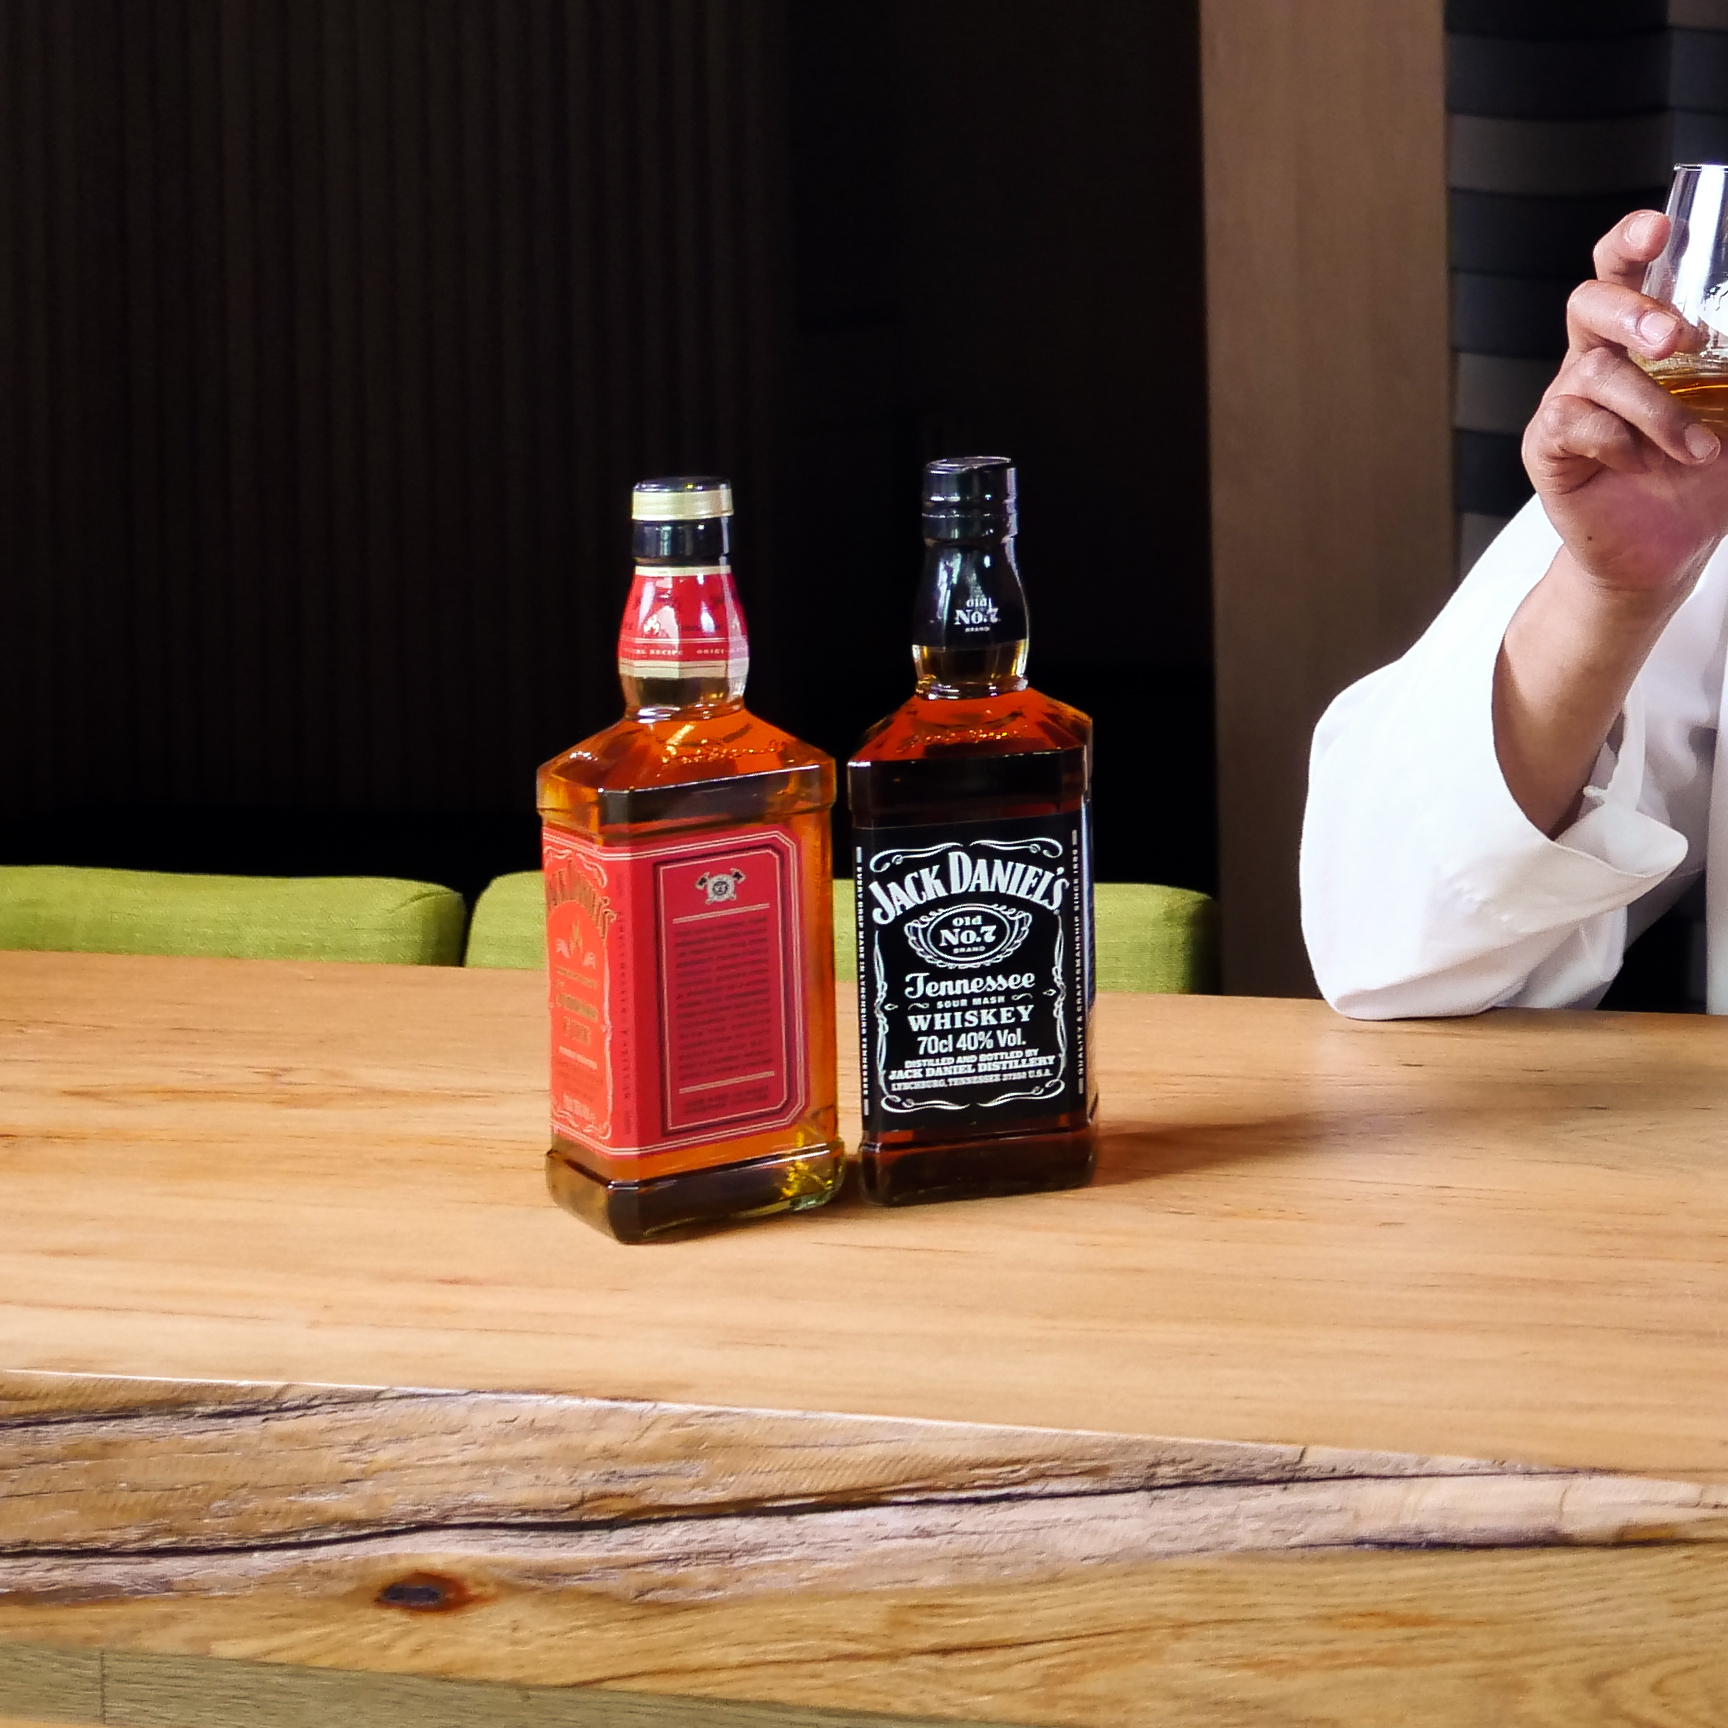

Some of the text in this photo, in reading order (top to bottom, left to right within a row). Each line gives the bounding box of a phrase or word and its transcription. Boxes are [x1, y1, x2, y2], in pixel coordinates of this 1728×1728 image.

[868, 851, 1070, 925] JACK DANIEL'S
[953, 915, 982, 926] Old
[939, 925, 997, 947] No.7
[953, 945, 985, 954] BRAND
[904, 972, 1035, 999] Tennessee
[936, 995, 1005, 1009] SOUR MASH
[907, 1004, 1035, 1032] WHISKEY
[917, 1027, 1027, 1055] 70cl 40% Vol.
[888, 1055, 1056, 1080] JACK DANIEL DISTILLERY
[904, 1048, 1039, 1069] DISTILLED AND BOTTLED BY
